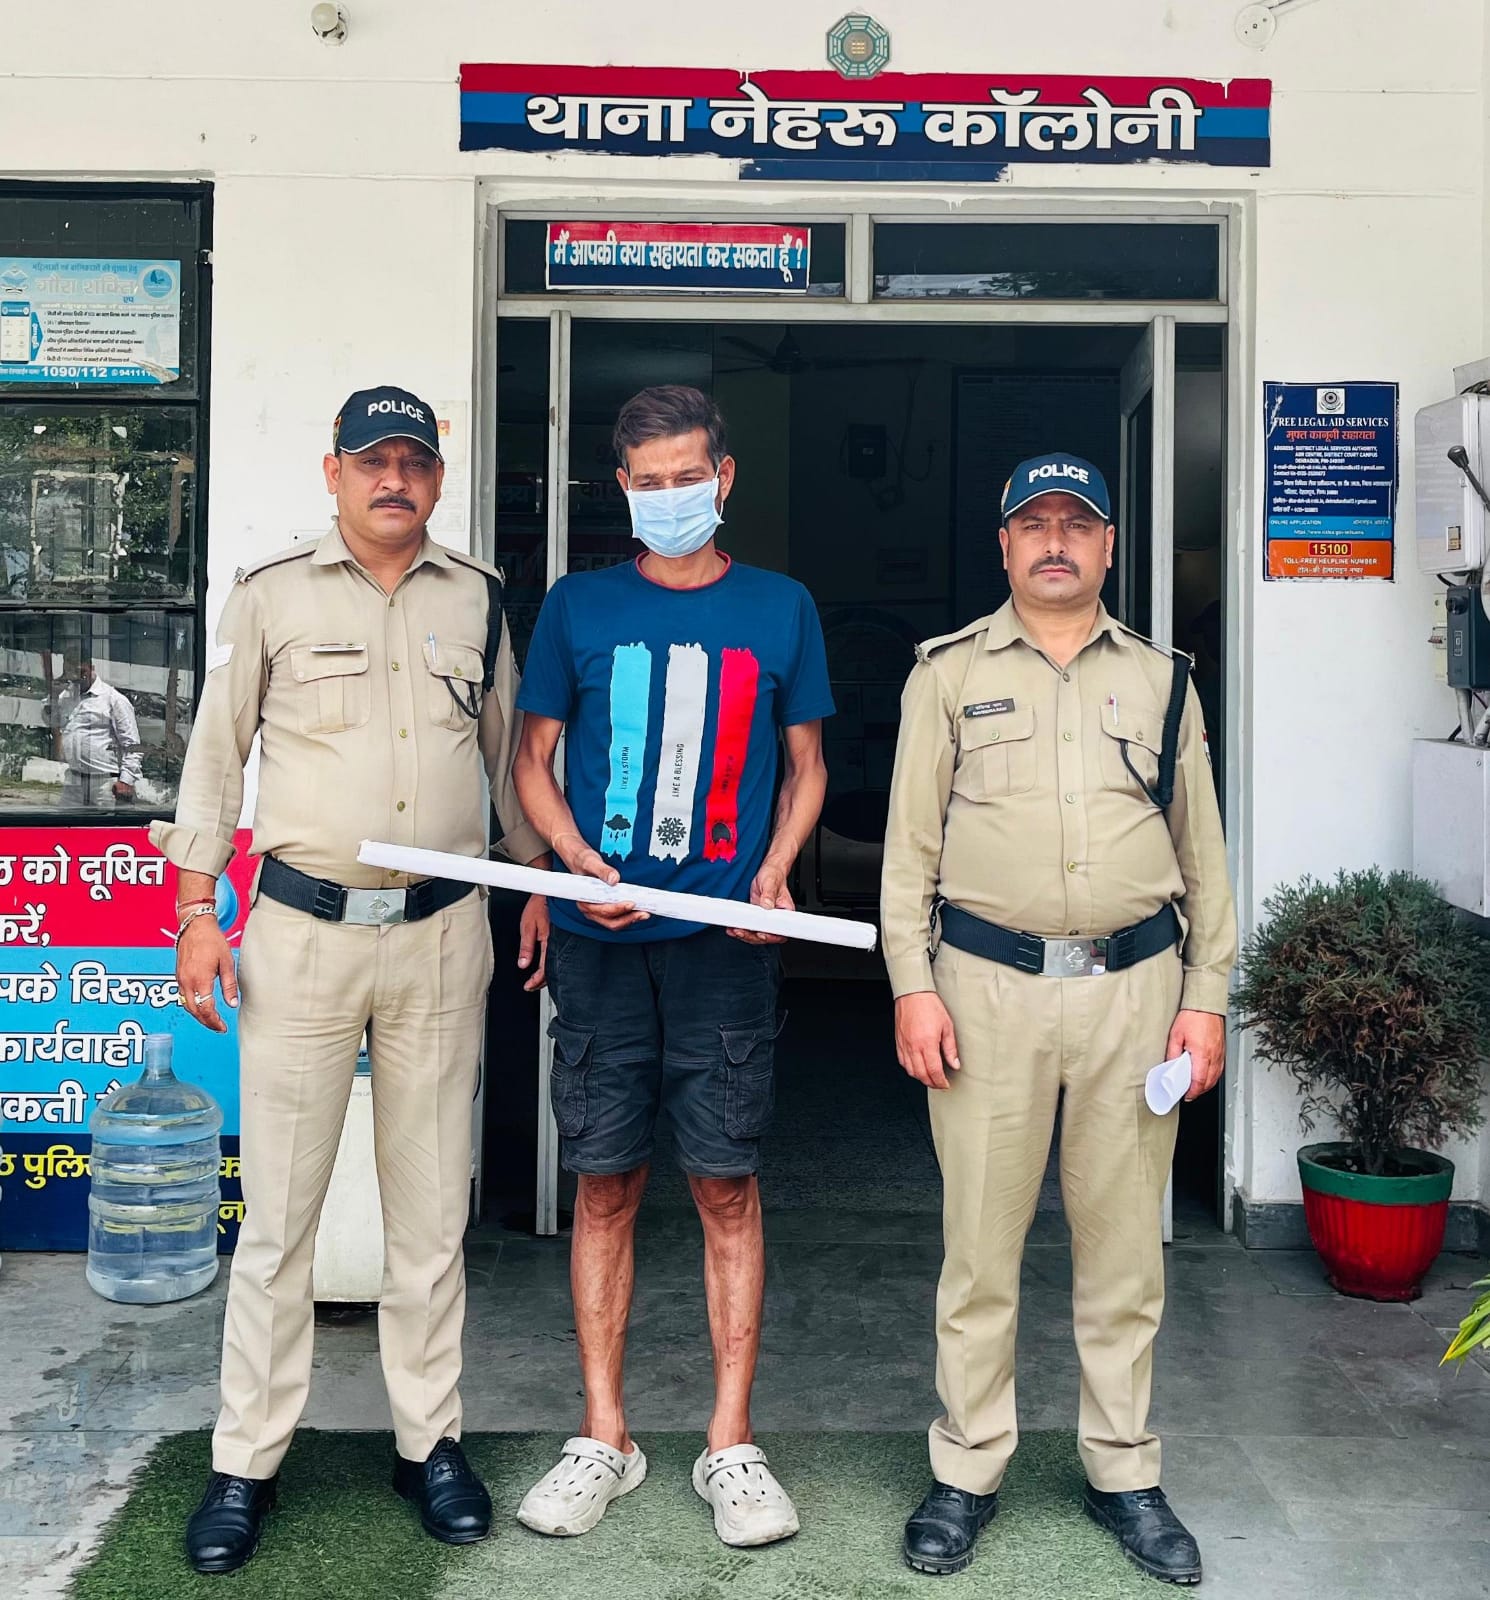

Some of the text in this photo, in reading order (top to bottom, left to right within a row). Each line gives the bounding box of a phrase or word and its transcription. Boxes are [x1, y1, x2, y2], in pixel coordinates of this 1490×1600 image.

[526, 82, 1202, 150] थाना नेहरू कॉलोनी
[554, 229, 569, 264] मैं
[569, 230, 617, 266] आपकी
[620, 241, 647, 266] क्या
[649, 242, 704, 269] सहायता
[706, 243, 731, 268] कर
[732, 243, 776, 269] सकता
[778, 233, 792, 282] हूँ
[41, 367, 107, 378] 1090/112
[367, 400, 426, 424] POLICE
[1274, 417, 1389, 427] FREE LEGAL AID SERVICES
[1028, 464, 1089, 485] POLICE
[1312, 544, 1348, 555] 15100
[1283, 557, 1378, 565] TOLL-FREE HELPLINE NUMBER
[621, 747, 630, 769] STORM
[674, 743, 685, 775] BLESSING
[672, 783, 680, 798] LIKE
[22, 845, 71, 885] को
[79, 844, 167, 900] दूषित
[23, 1145, 92, 1189] पुलि
